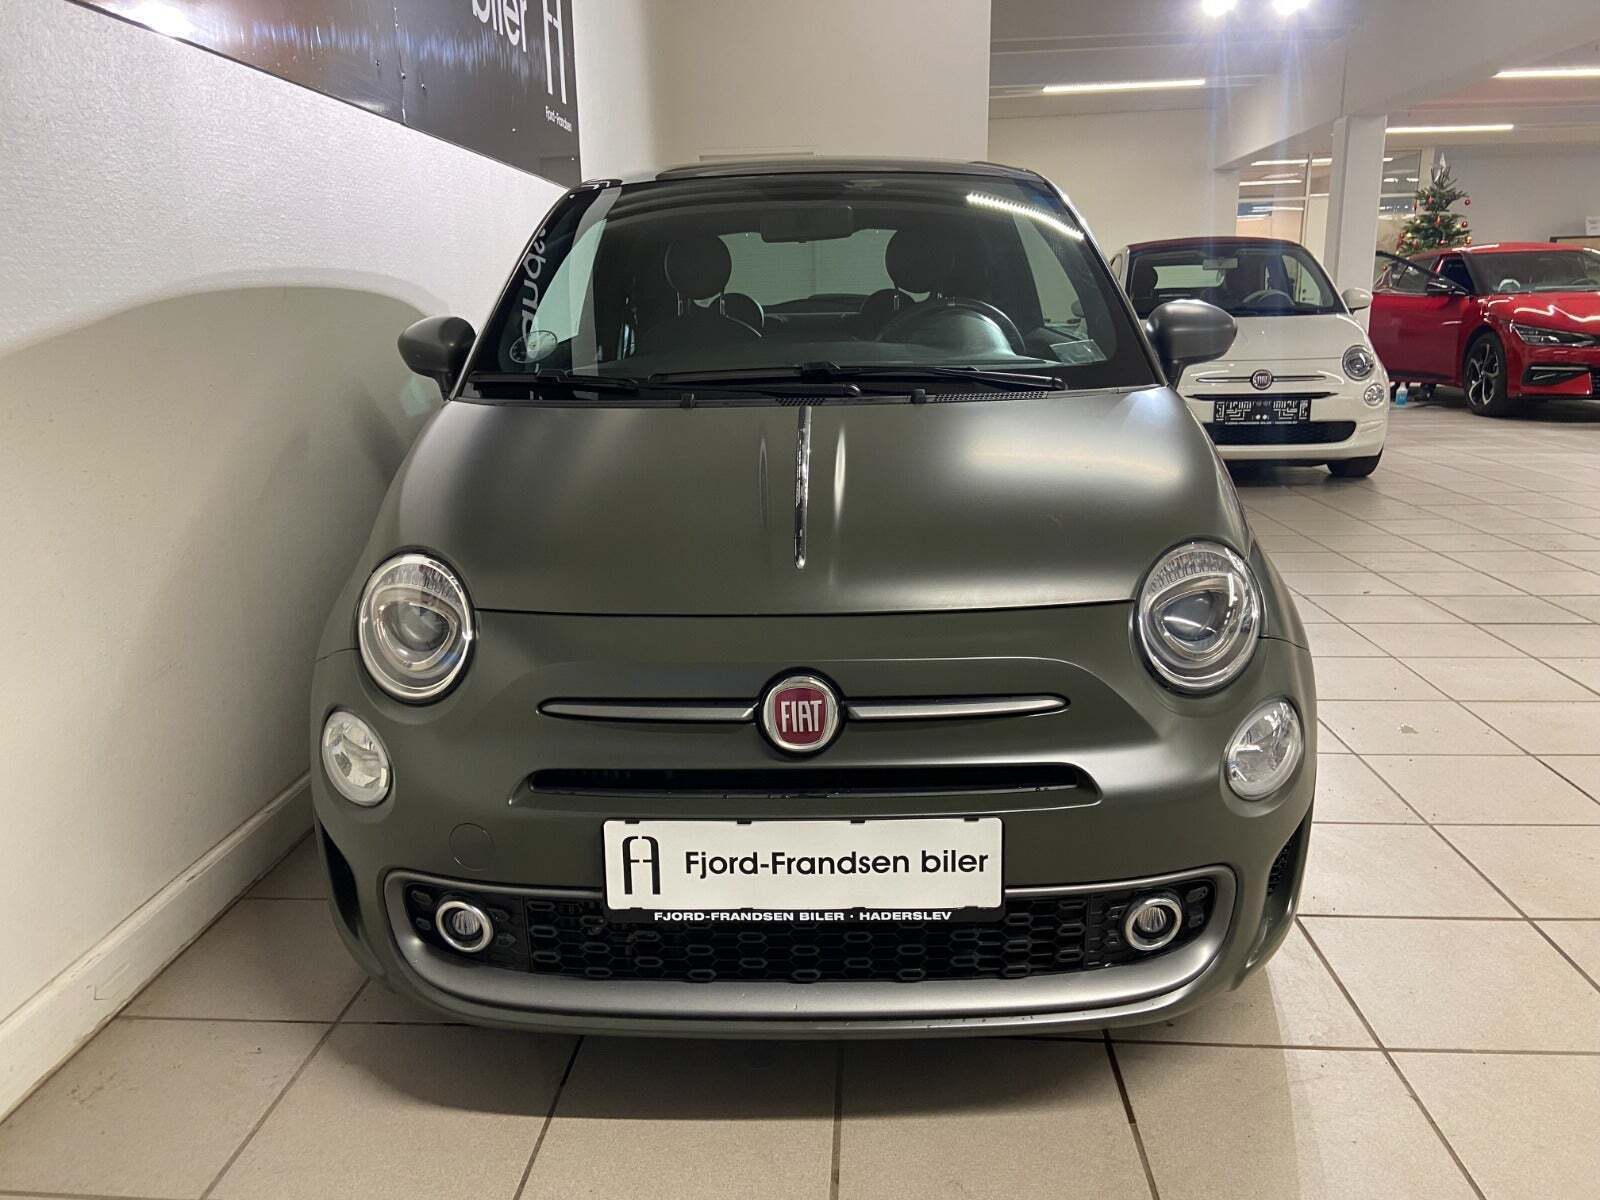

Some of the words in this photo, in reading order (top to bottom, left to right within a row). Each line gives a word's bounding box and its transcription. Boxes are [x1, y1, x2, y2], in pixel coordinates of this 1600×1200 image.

[780, 700, 823, 733] FIAT
[685, 851, 910, 880] Fjord-Frandsen
[921, 849, 989, 873] biler
[654, 911, 794, 922] FJORD-FRANDSEN
[799, 911, 845, 921] BILER
[859, 911, 952, 921] HADERSLEV
